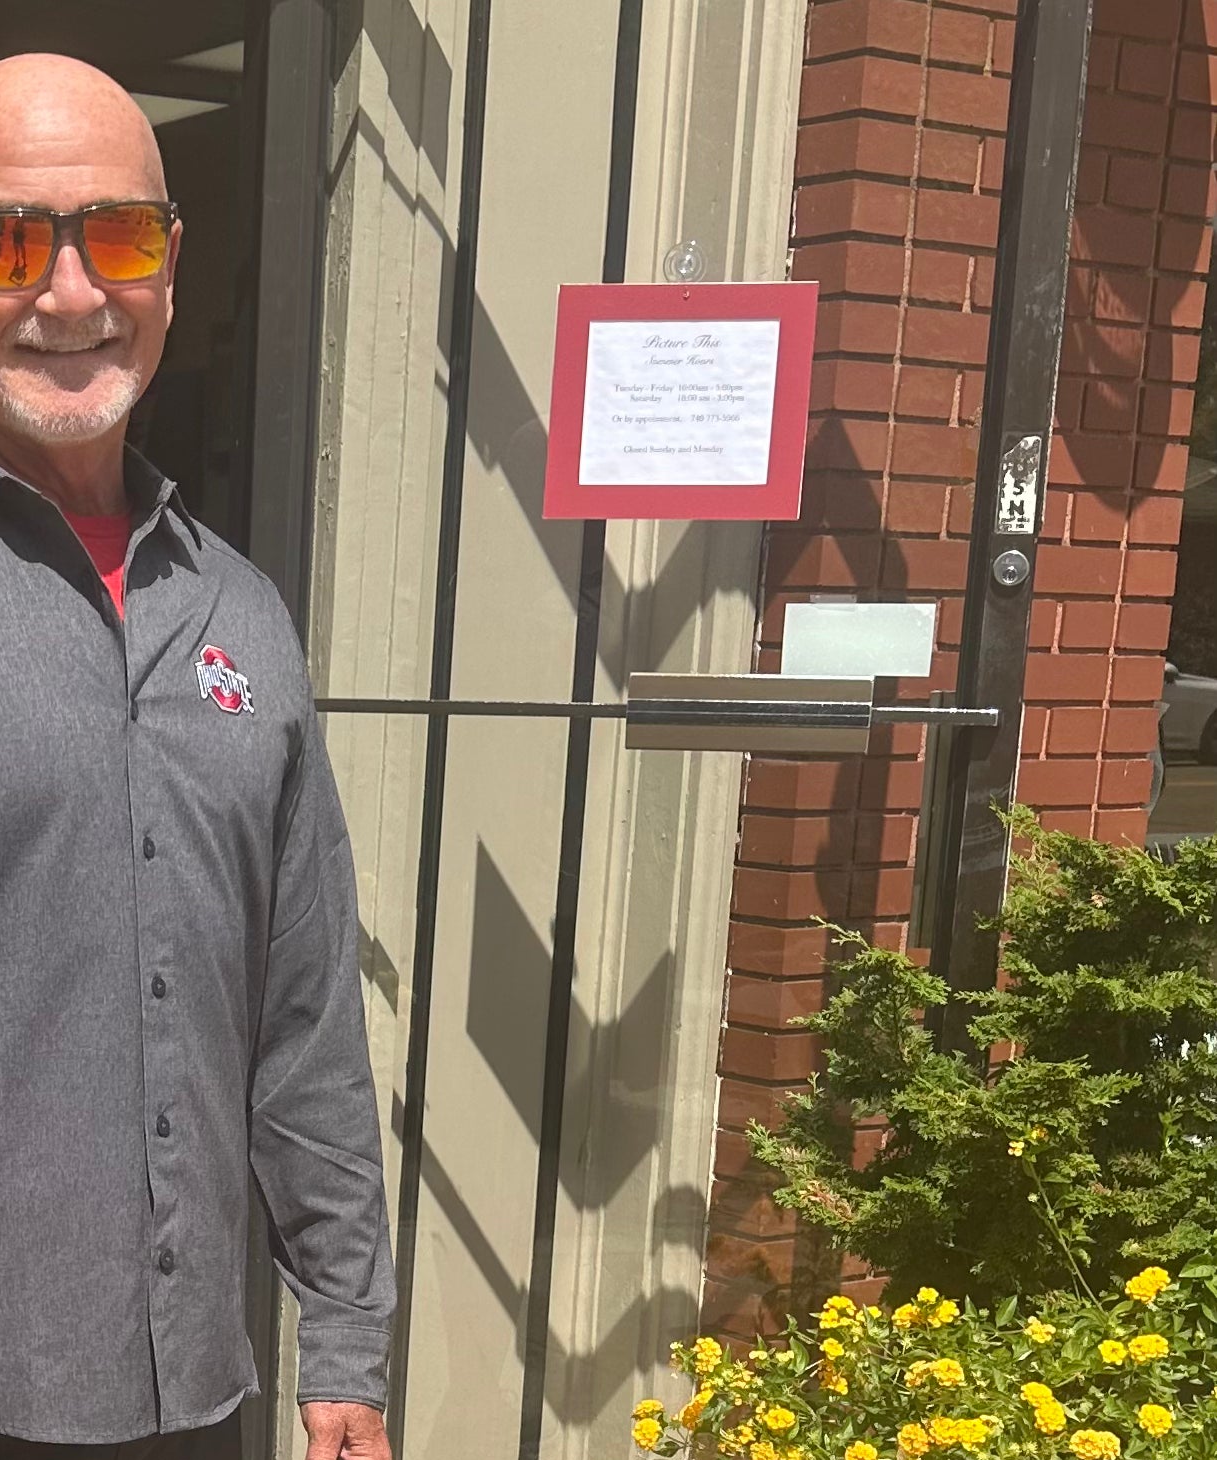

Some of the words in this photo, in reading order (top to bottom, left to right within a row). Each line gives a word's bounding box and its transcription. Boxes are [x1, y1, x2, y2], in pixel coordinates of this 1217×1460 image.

[642, 334, 689, 349] Picture
[691, 334, 722, 349] This
[645, 354, 683, 366] Summer
[685, 354, 715, 366] Hours
[650, 384, 674, 393] Friday
[623, 445, 647, 453] Closed
[678, 445, 691, 453] and
[693, 445, 724, 454] Monday
